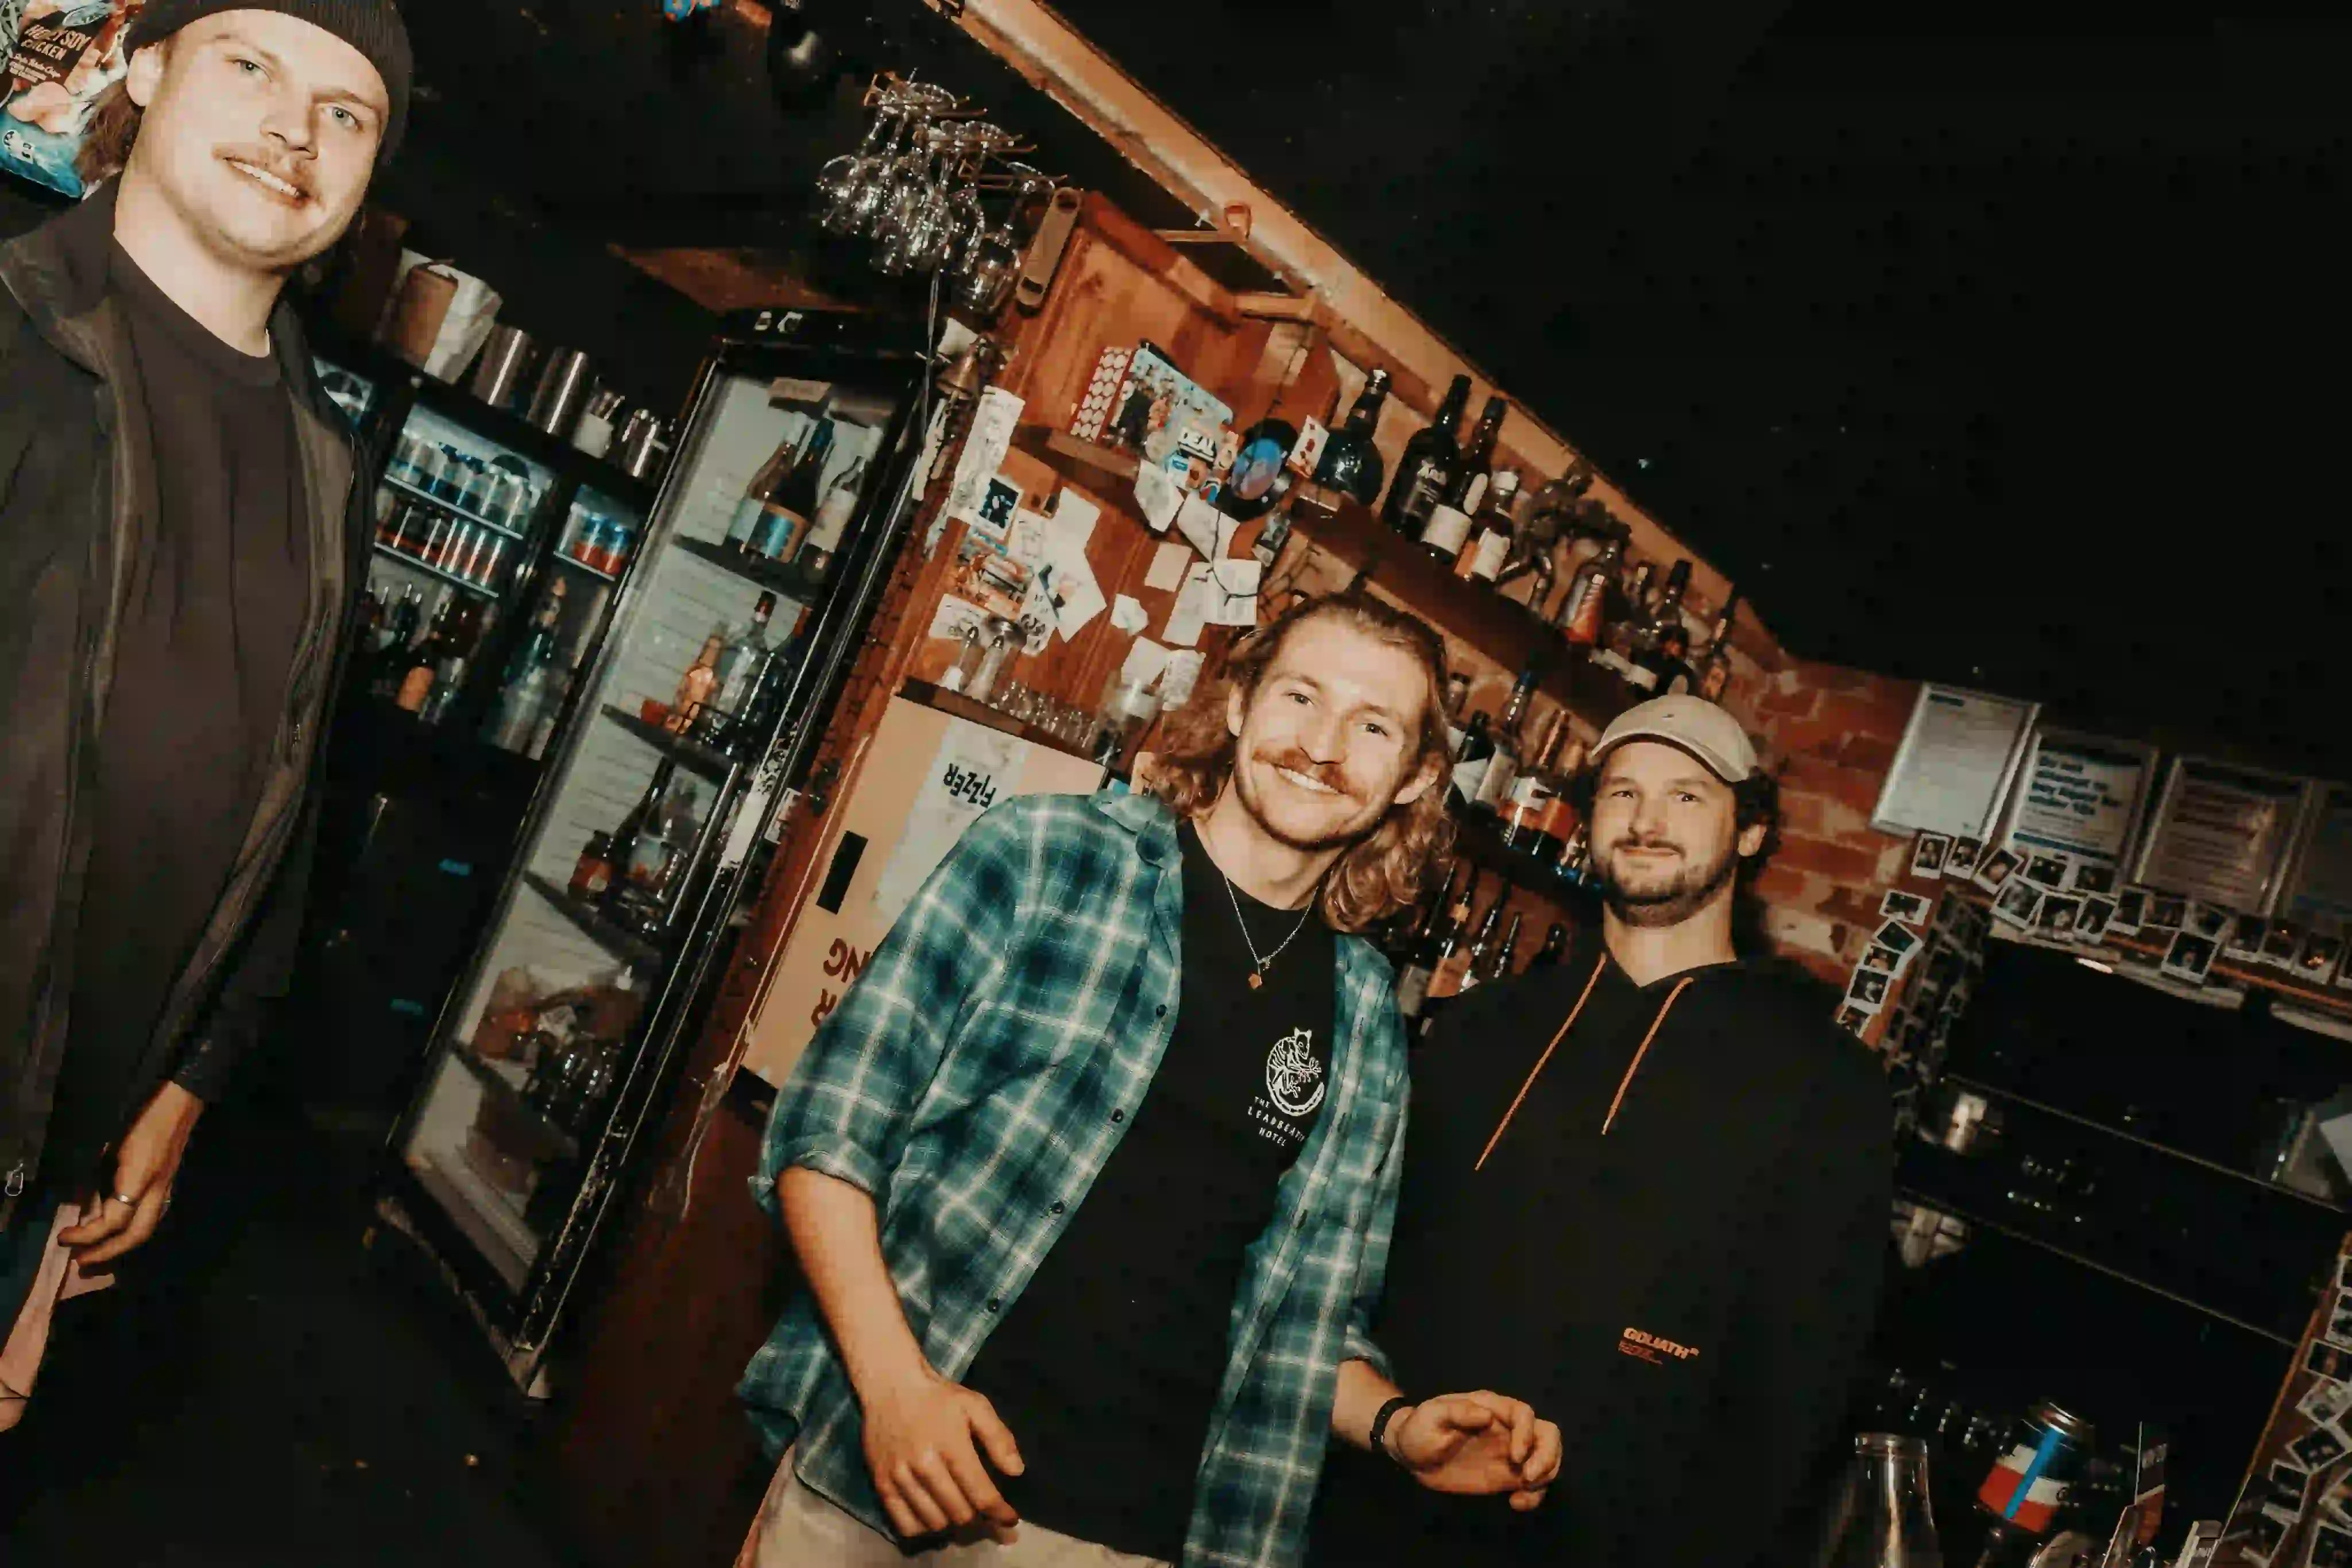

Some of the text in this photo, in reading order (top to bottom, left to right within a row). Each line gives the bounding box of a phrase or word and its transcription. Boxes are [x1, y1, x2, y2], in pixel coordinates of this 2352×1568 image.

[60, 29, 91, 51] SOY
[943, 762, 997, 809] FIZZER
[1259, 1126, 1287, 1147] HOTEL
